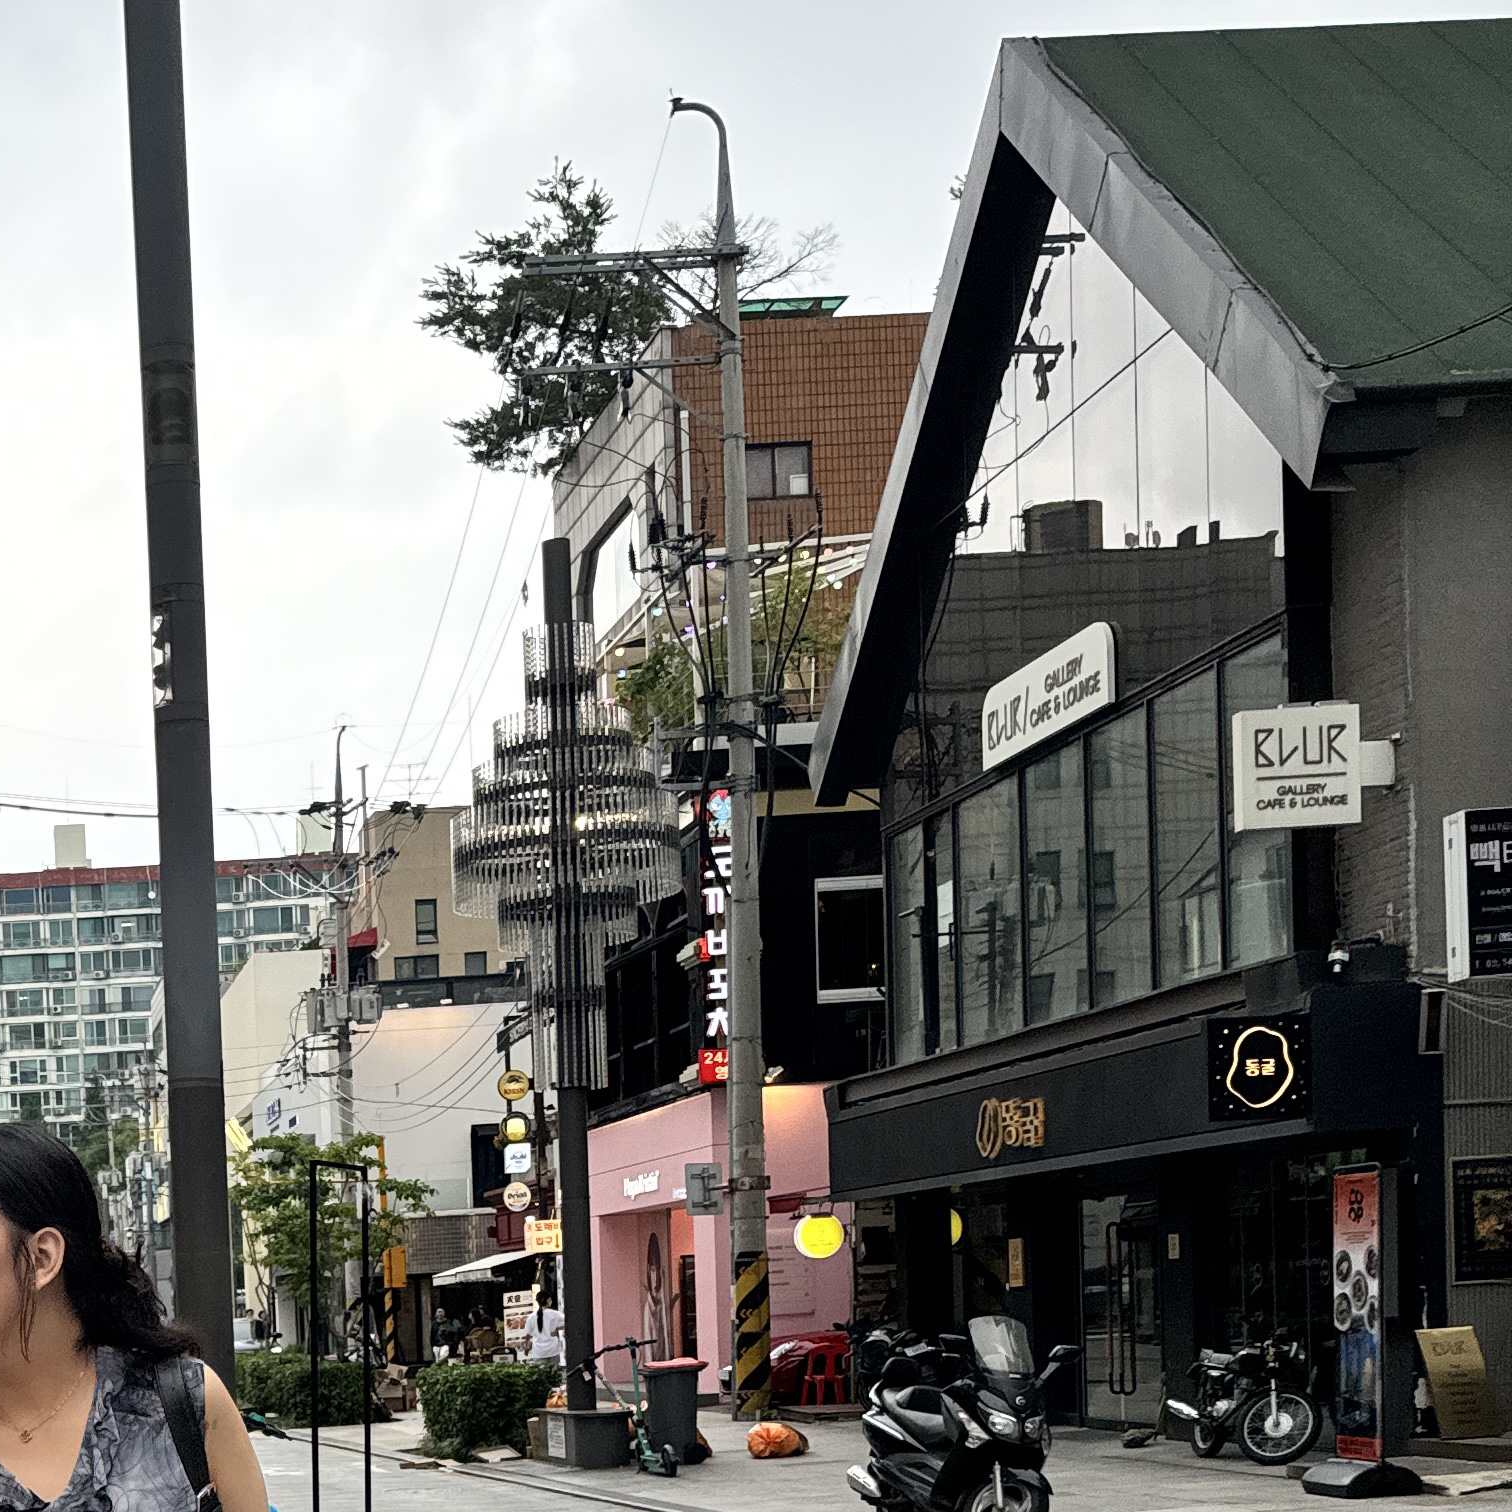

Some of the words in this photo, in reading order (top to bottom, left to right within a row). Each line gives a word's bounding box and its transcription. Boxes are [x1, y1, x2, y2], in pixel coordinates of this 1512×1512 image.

[1044, 653, 1083, 694] GALLERY
[1030, 699, 1052, 728] CAFE
[1053, 694, 1061, 715] &
[1062, 670, 1101, 711] LOUNGE
[1254, 724, 1347, 768] BLUR
[1256, 797, 1286, 811] CAFE
[1289, 797, 1298, 809] &
[1301, 793, 1348, 808] LOUNGE
[1276, 783, 1327, 797] GALLERY
[1245, 1058, 1276, 1076] 동굴
